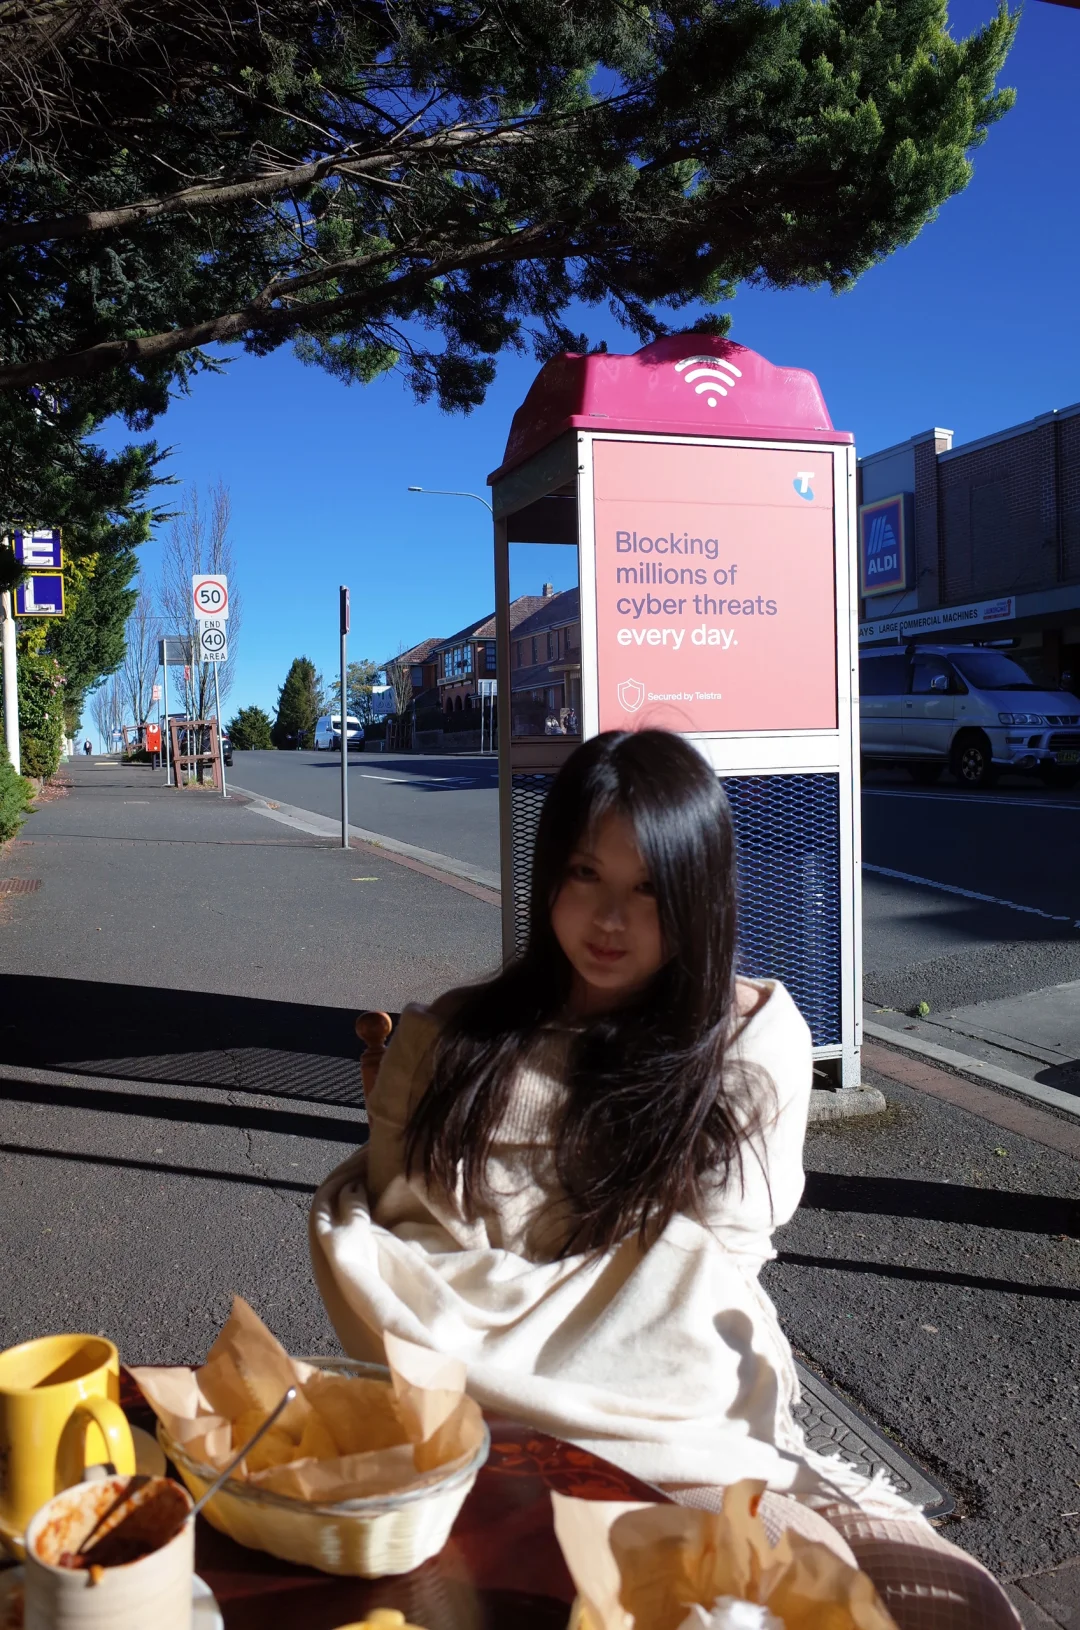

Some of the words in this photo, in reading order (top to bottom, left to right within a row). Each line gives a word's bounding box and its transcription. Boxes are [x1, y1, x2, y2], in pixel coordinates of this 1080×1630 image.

[797, 472, 815, 493] T
[616, 530, 719, 560] Blocking
[616, 562, 708, 585] millions
[713, 564, 738, 585] of
[867, 553, 897, 576] ALDI
[200, 590, 221, 604] 50
[616, 593, 687, 619] cyber
[692, 593, 778, 616] threats
[204, 620, 221, 629] END
[878, 622, 898, 634] LARGE
[899, 616, 942, 630] COMMERCIAL
[942, 609, 978, 623] MACHINES
[204, 634, 222, 646] 40
[616, 628, 686, 650] every
[690, 623, 738, 650] day.
[203, 652, 226, 661] AREA
[647, 692, 682, 701] Secured
[683, 692, 694, 702] by
[695, 691, 722, 700] Telstra
